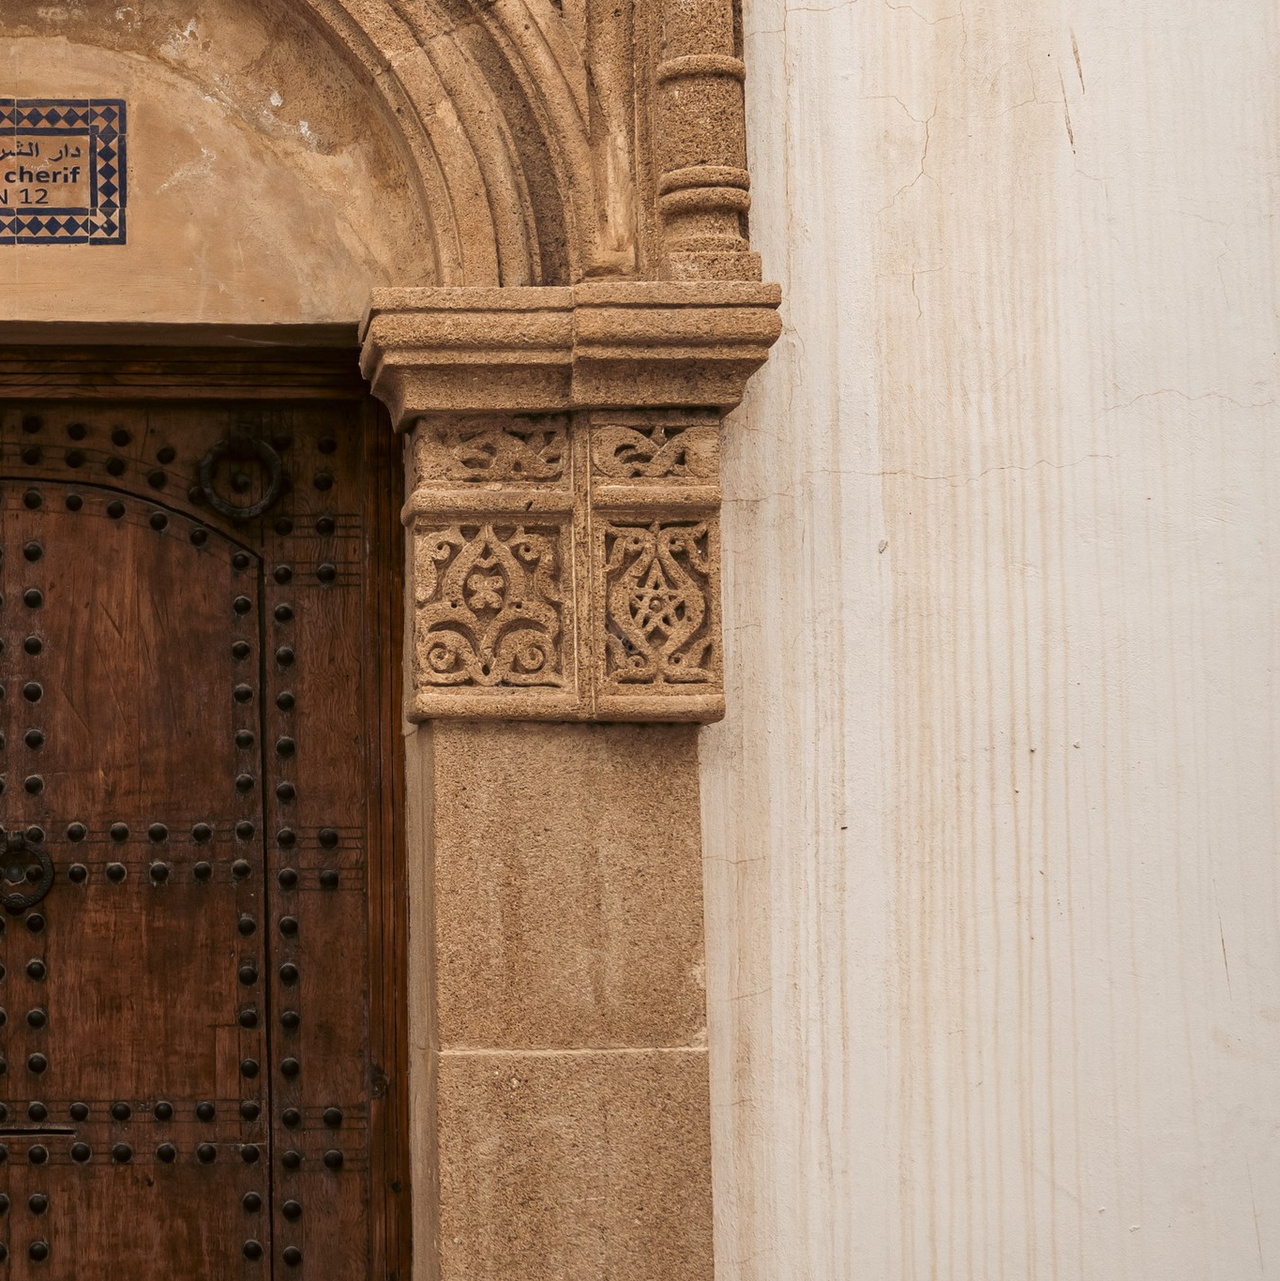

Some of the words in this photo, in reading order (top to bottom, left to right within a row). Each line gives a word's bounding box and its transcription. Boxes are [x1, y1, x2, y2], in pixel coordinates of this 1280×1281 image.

[47, 144, 81, 161] دار
[4, 166, 81, 183] cherif
[19, 188, 49, 205] 12
